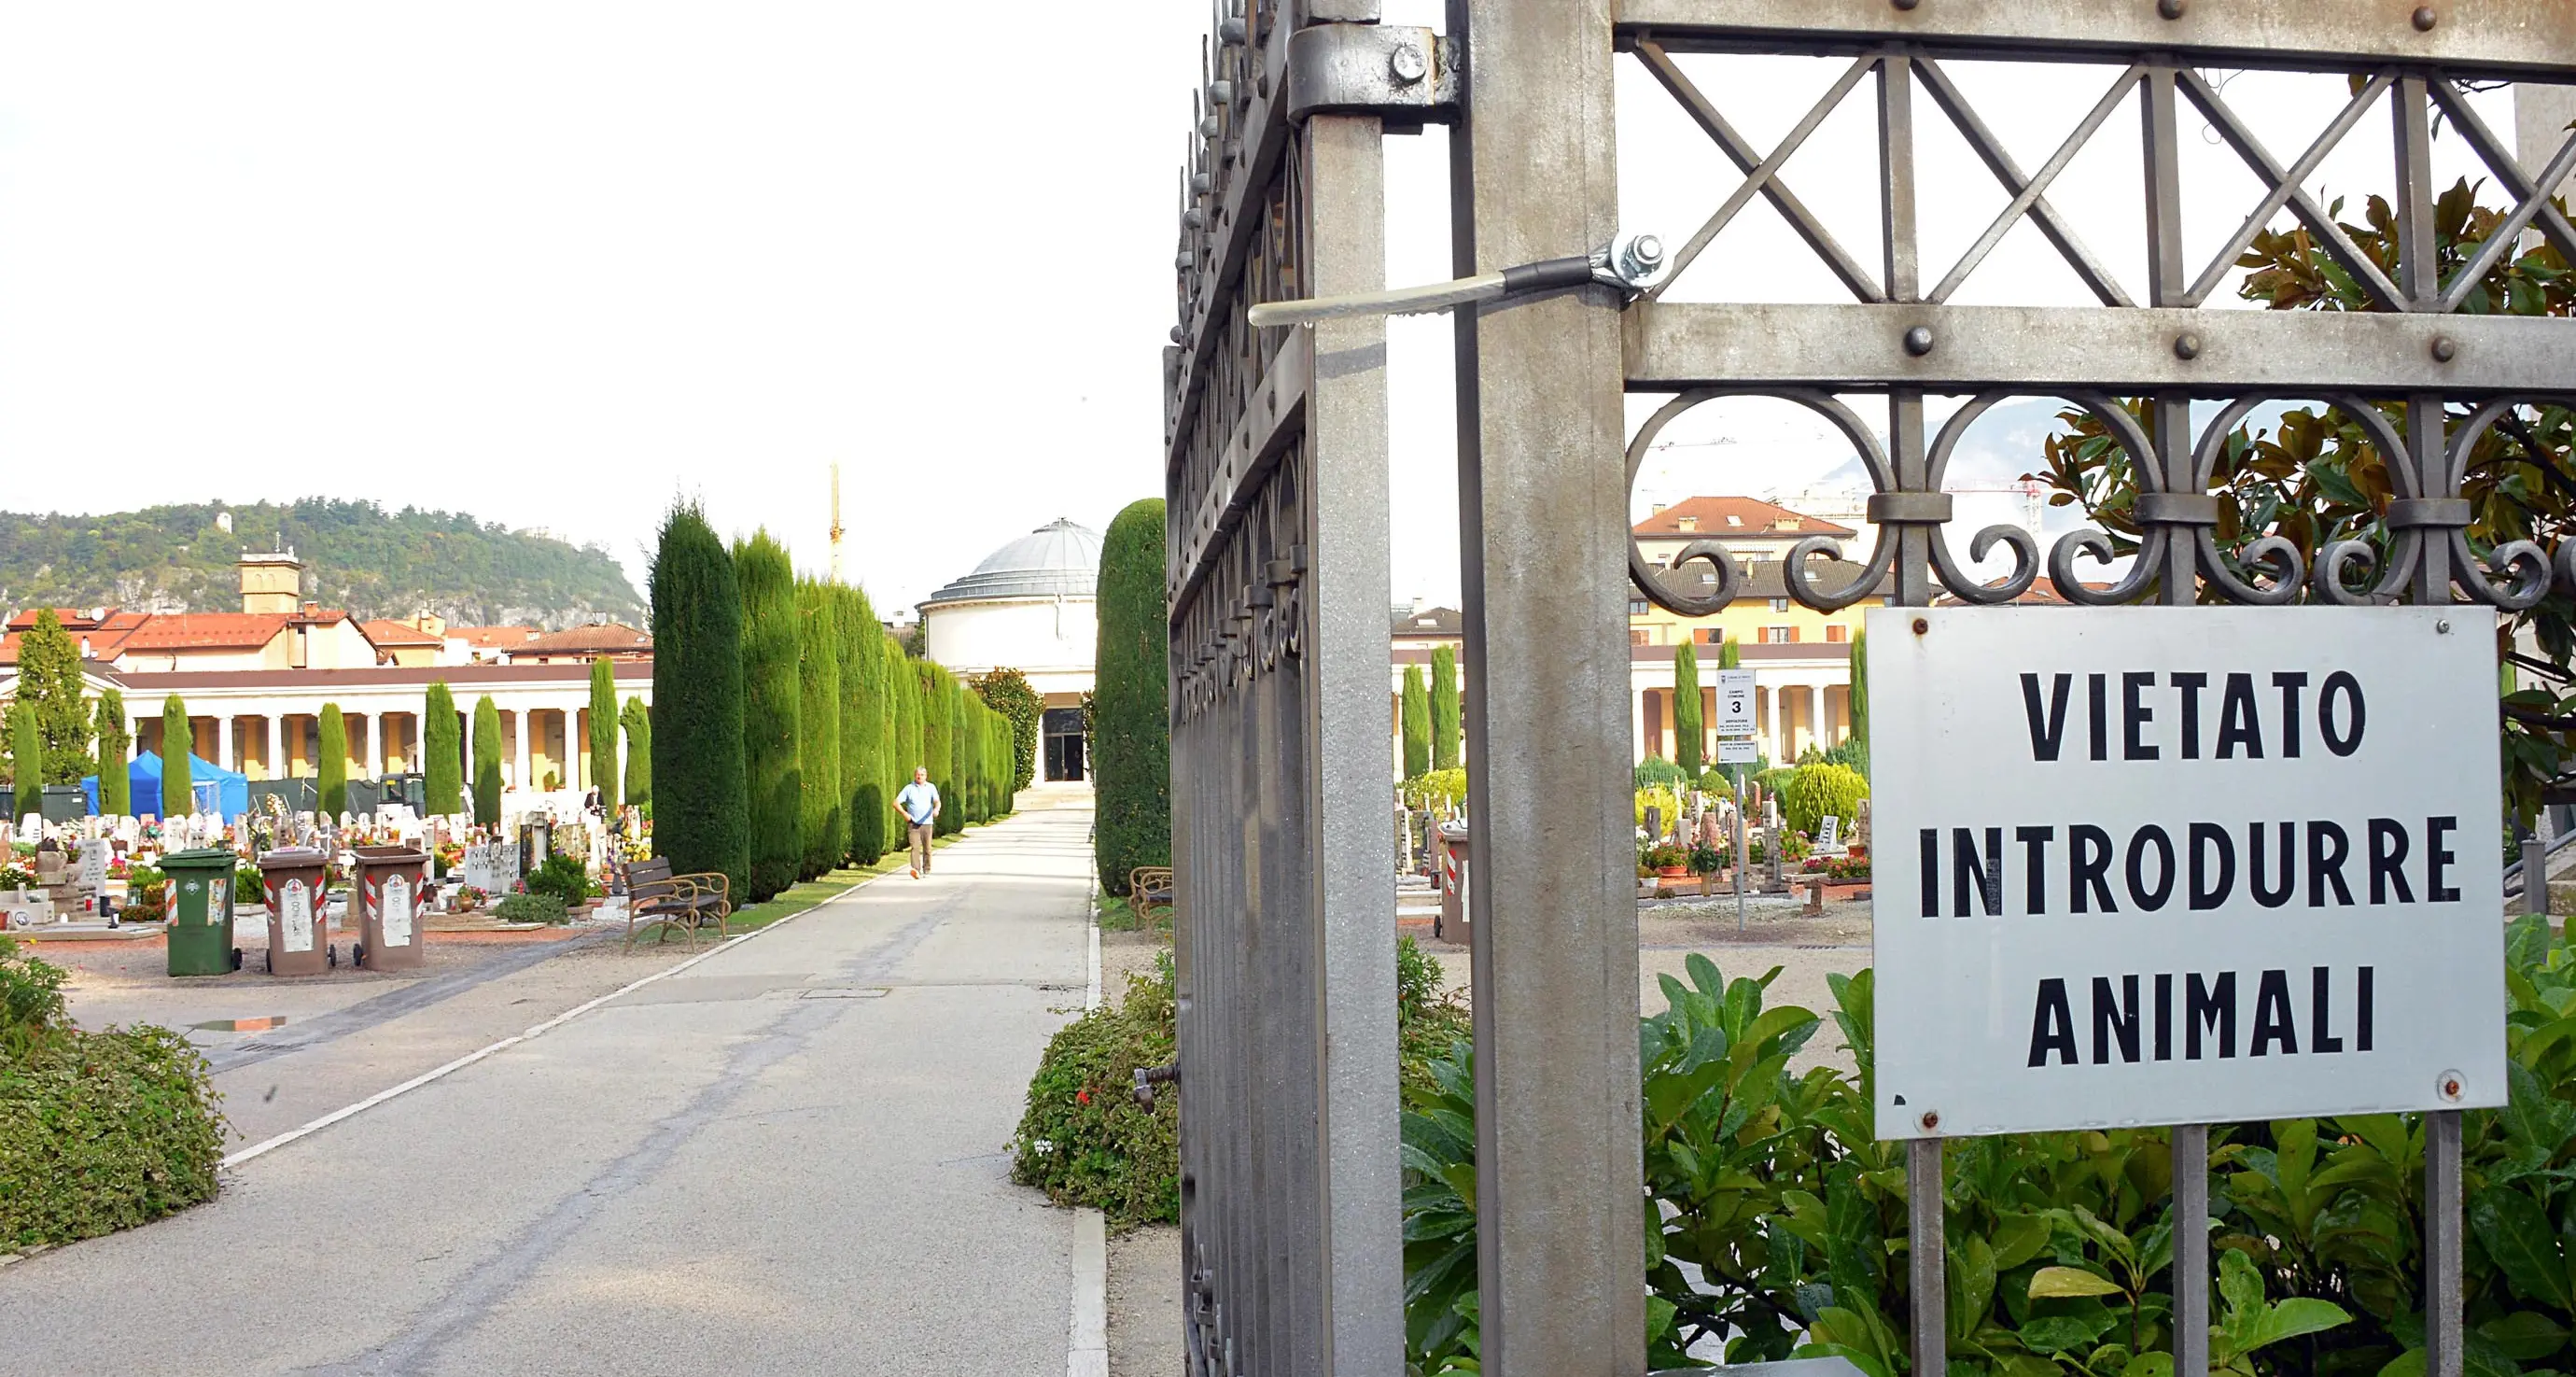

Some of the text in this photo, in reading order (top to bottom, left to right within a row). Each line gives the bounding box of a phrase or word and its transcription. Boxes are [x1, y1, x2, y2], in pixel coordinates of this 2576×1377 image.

[1731, 700, 1742, 713] 3
[2020, 670, 2366, 762] VIETATO
[1919, 816, 2462, 919] INTRODURRE
[2026, 965, 2374, 1069] ANIMALI
